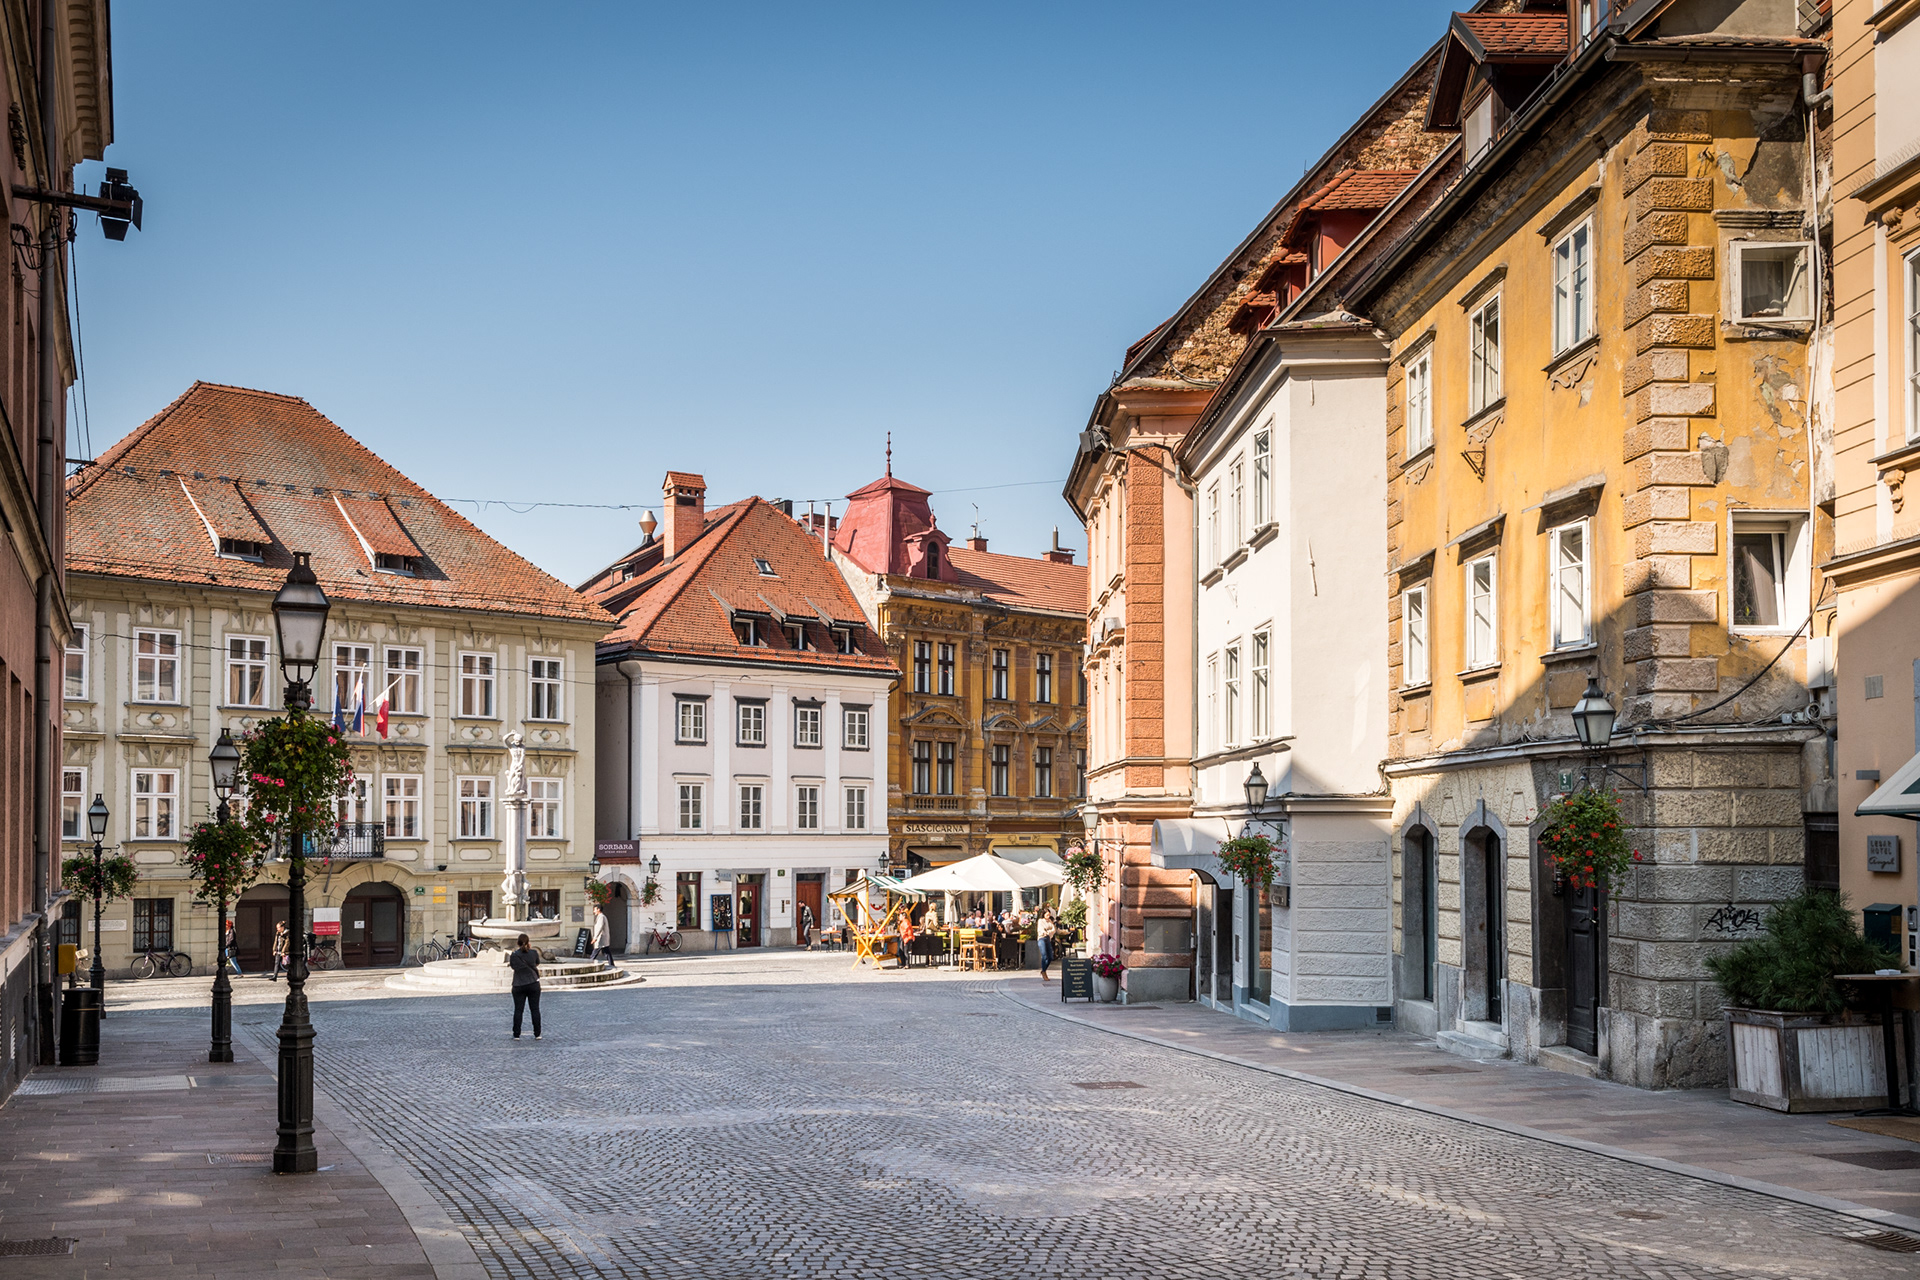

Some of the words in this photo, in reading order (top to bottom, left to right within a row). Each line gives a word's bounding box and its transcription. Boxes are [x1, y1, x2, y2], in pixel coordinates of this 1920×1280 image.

[1562, 773, 1567, 784] 5
[1870, 840, 1892, 848] LESAR
[1870, 847, 1892, 855] HOTEL
